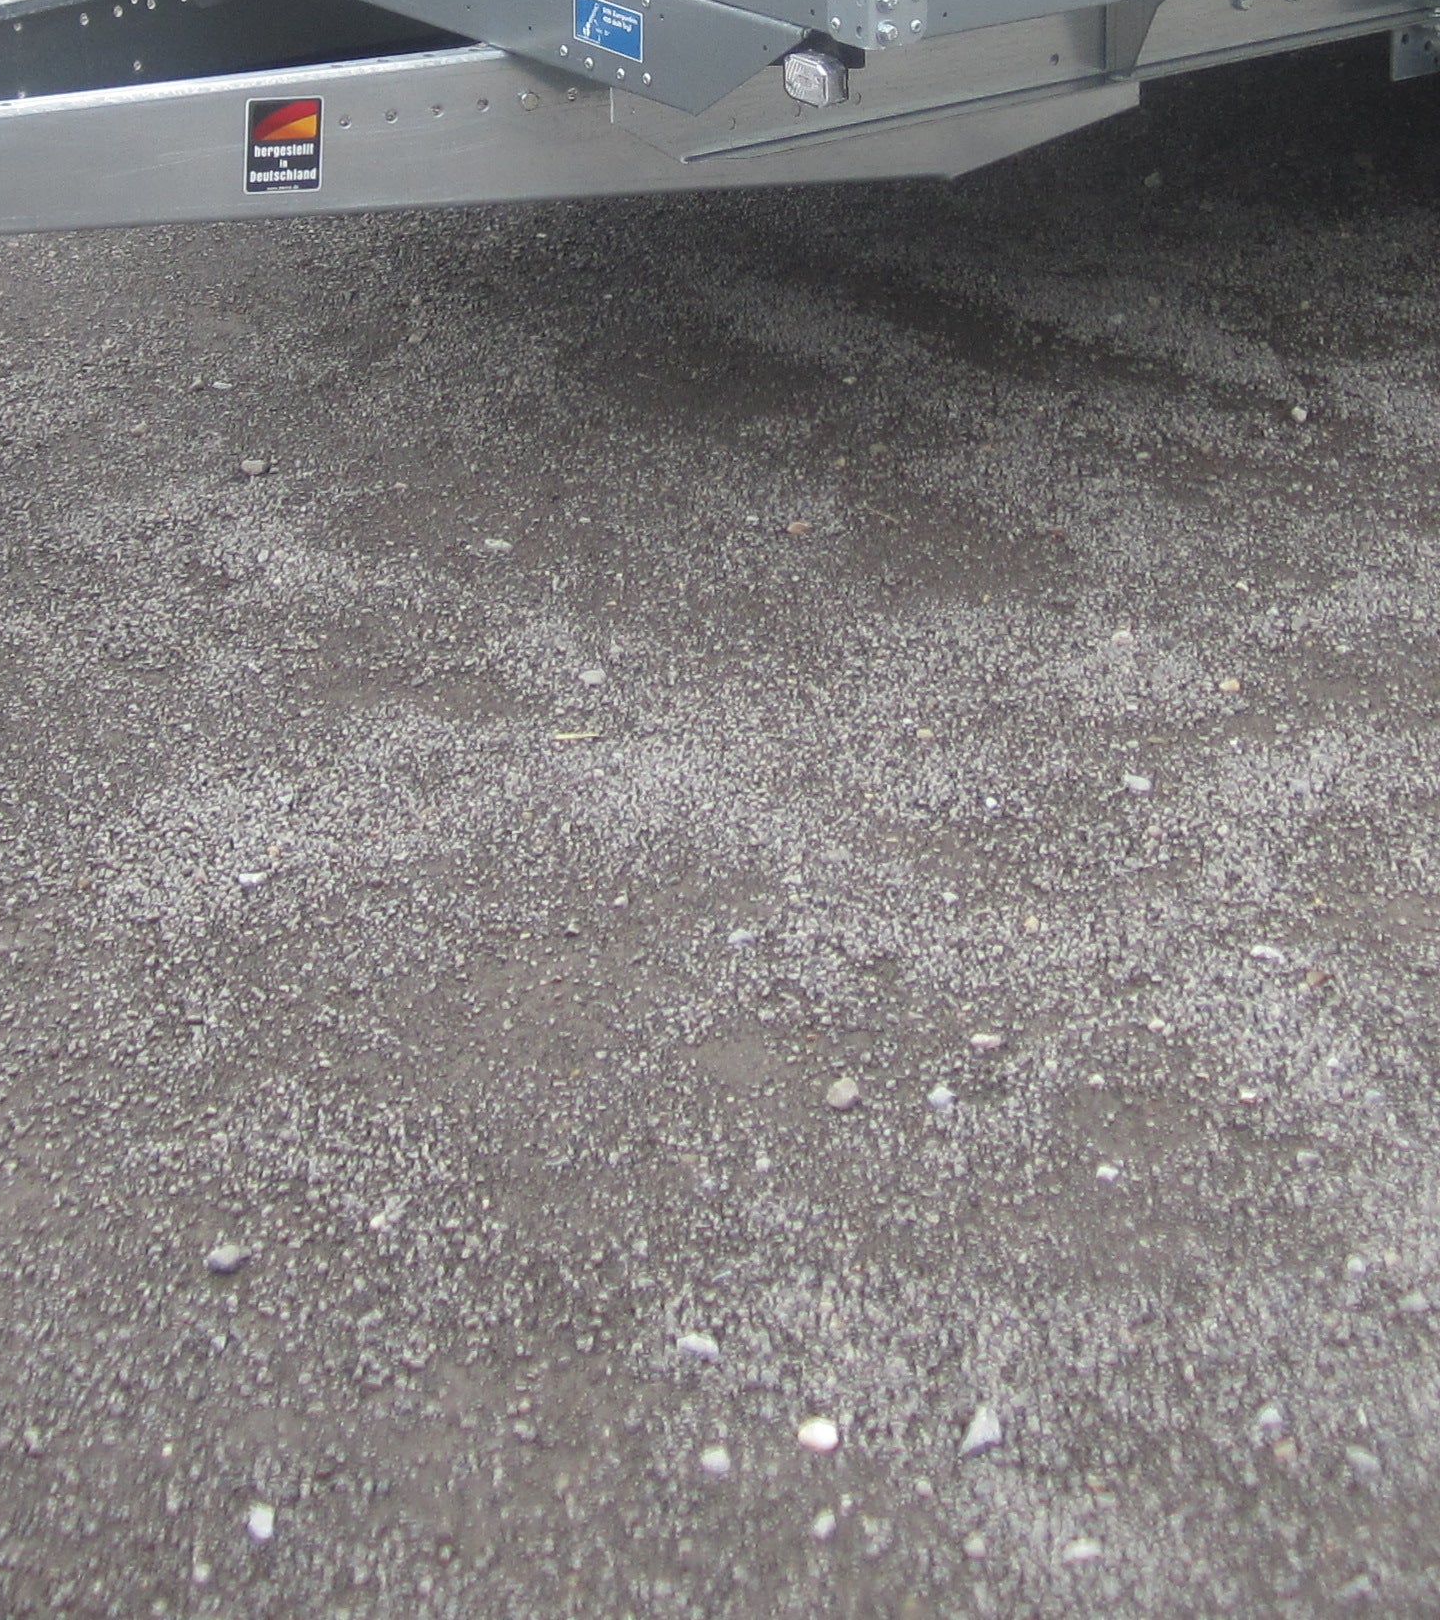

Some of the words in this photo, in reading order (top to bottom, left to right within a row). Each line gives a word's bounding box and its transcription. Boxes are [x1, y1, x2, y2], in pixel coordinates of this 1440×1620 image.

[254, 143, 314, 158] hergestellt
[279, 159, 288, 168] in
[249, 168, 317, 183] Deutschland
